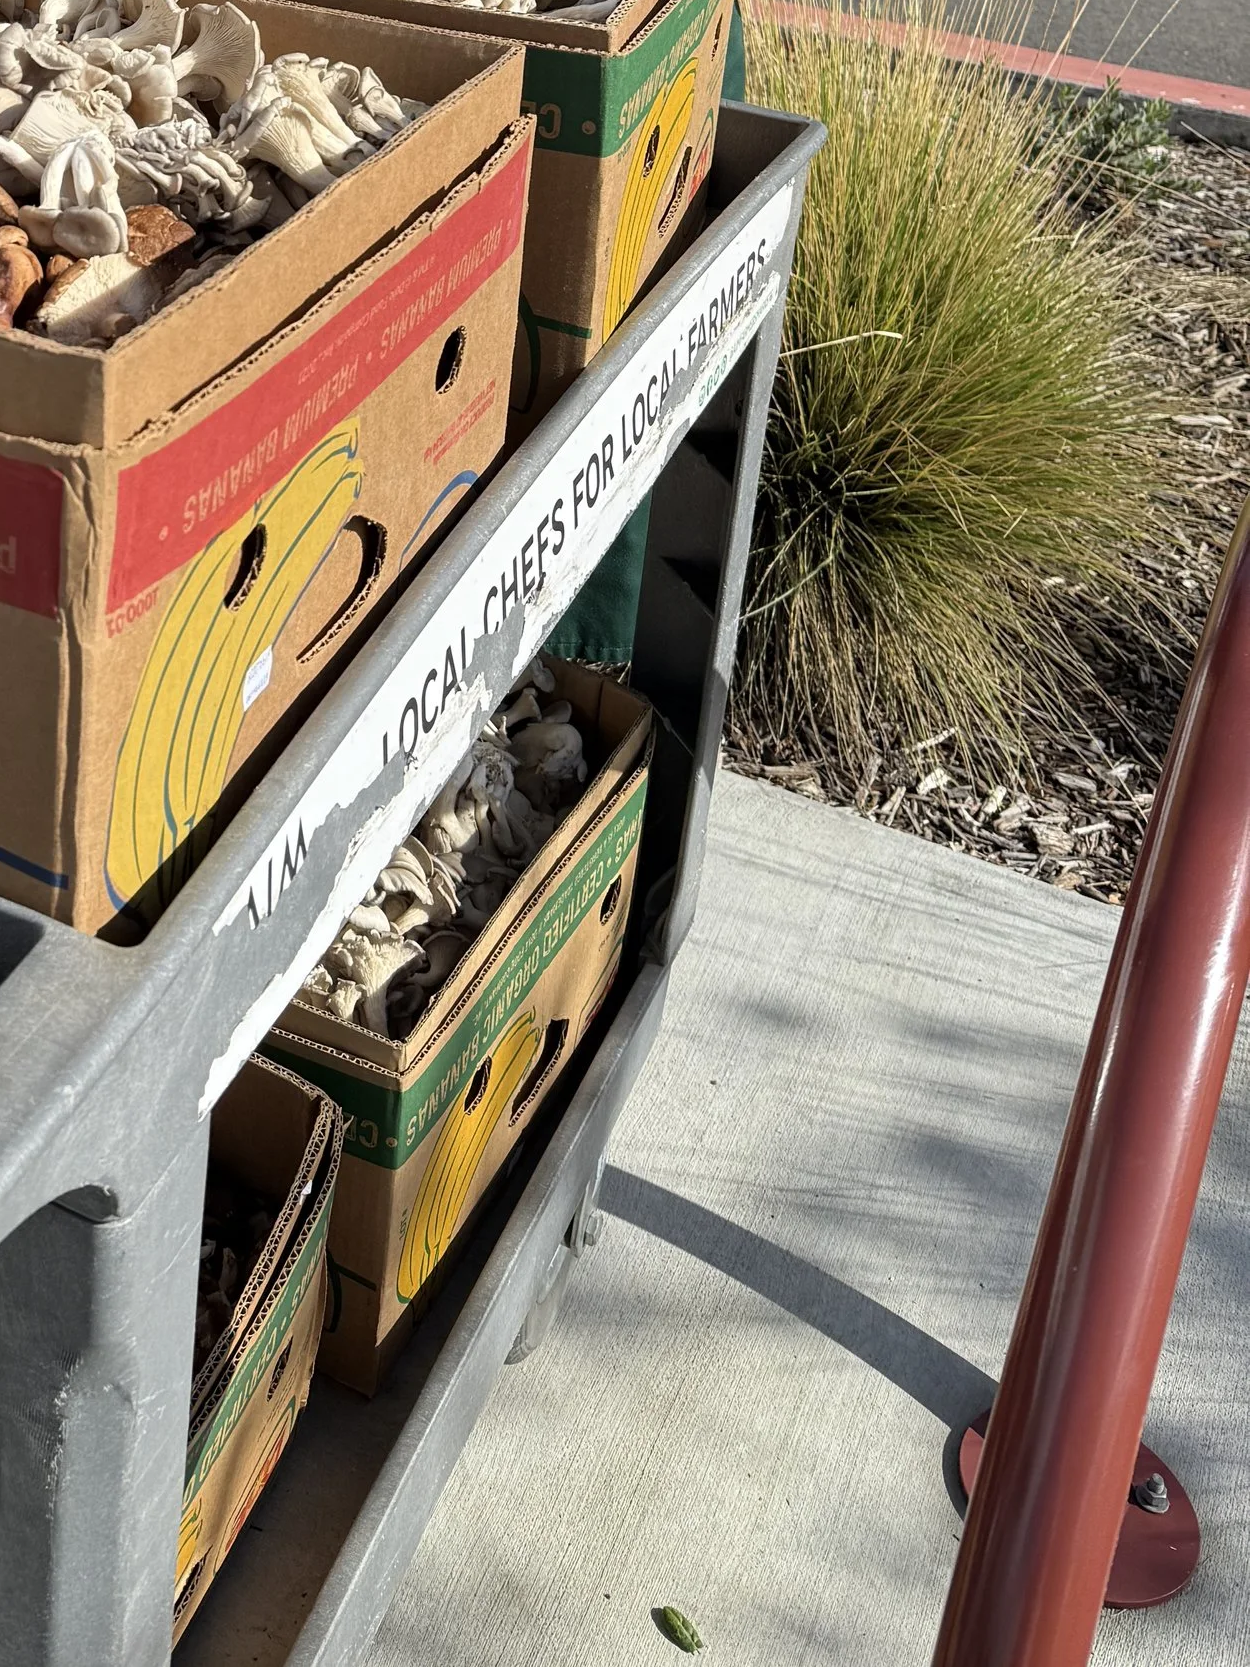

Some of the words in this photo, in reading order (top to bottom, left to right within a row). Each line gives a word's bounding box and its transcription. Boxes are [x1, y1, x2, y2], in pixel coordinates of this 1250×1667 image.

[446, 226, 502, 299] PREMIUM
[380, 275, 447, 360] BANANAS
[283, 354, 360, 451] PREMIUM
[483, 498, 565, 636] CHEFS
[572, 434, 614, 531] FOR
[687, 237, 767, 367] FARMERS
[182, 430, 279, 534] BANANAS
[542, 858, 606, 959] CERTIFIED
[482, 946, 541, 1047] ORGANIC
[406, 1027, 480, 1147] BANANAS
